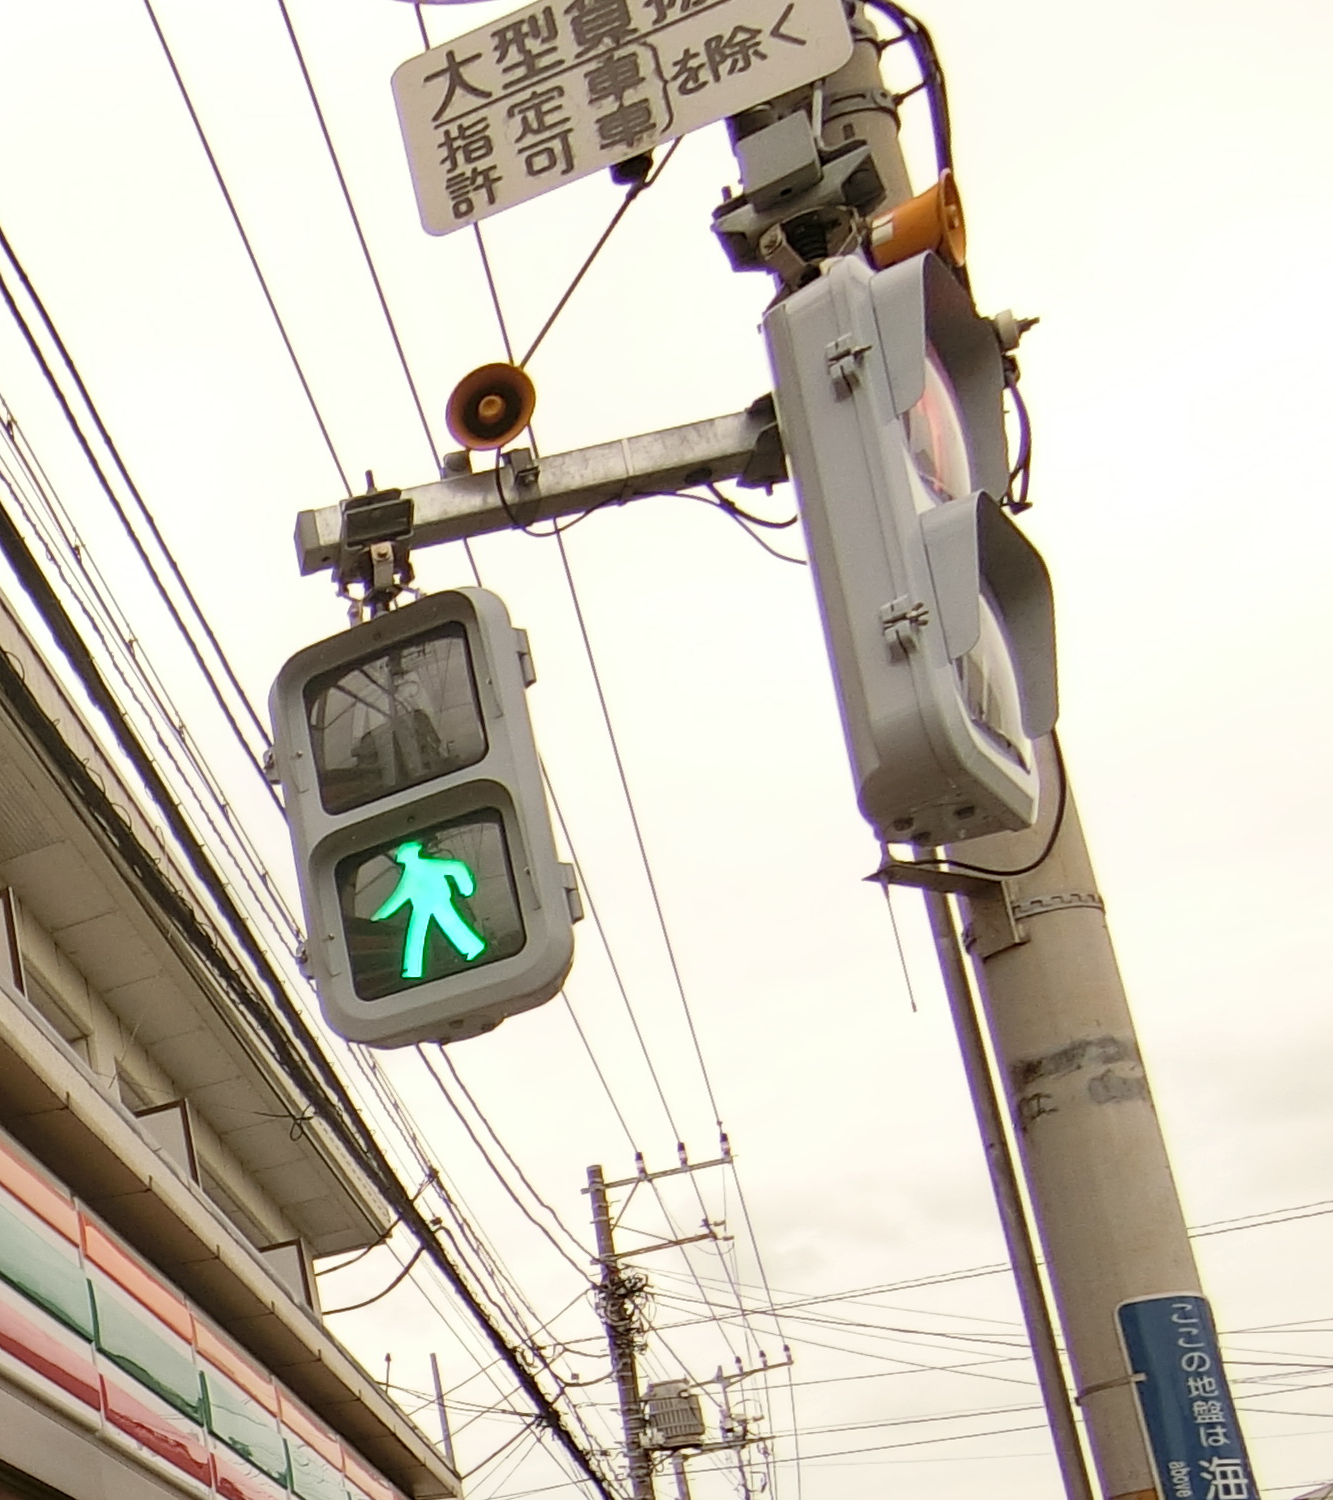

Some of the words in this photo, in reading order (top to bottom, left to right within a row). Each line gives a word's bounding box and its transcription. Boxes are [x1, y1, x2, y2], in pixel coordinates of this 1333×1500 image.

[671, 3, 807, 95] を除く
[1168, 1461, 1192, 1498] above
